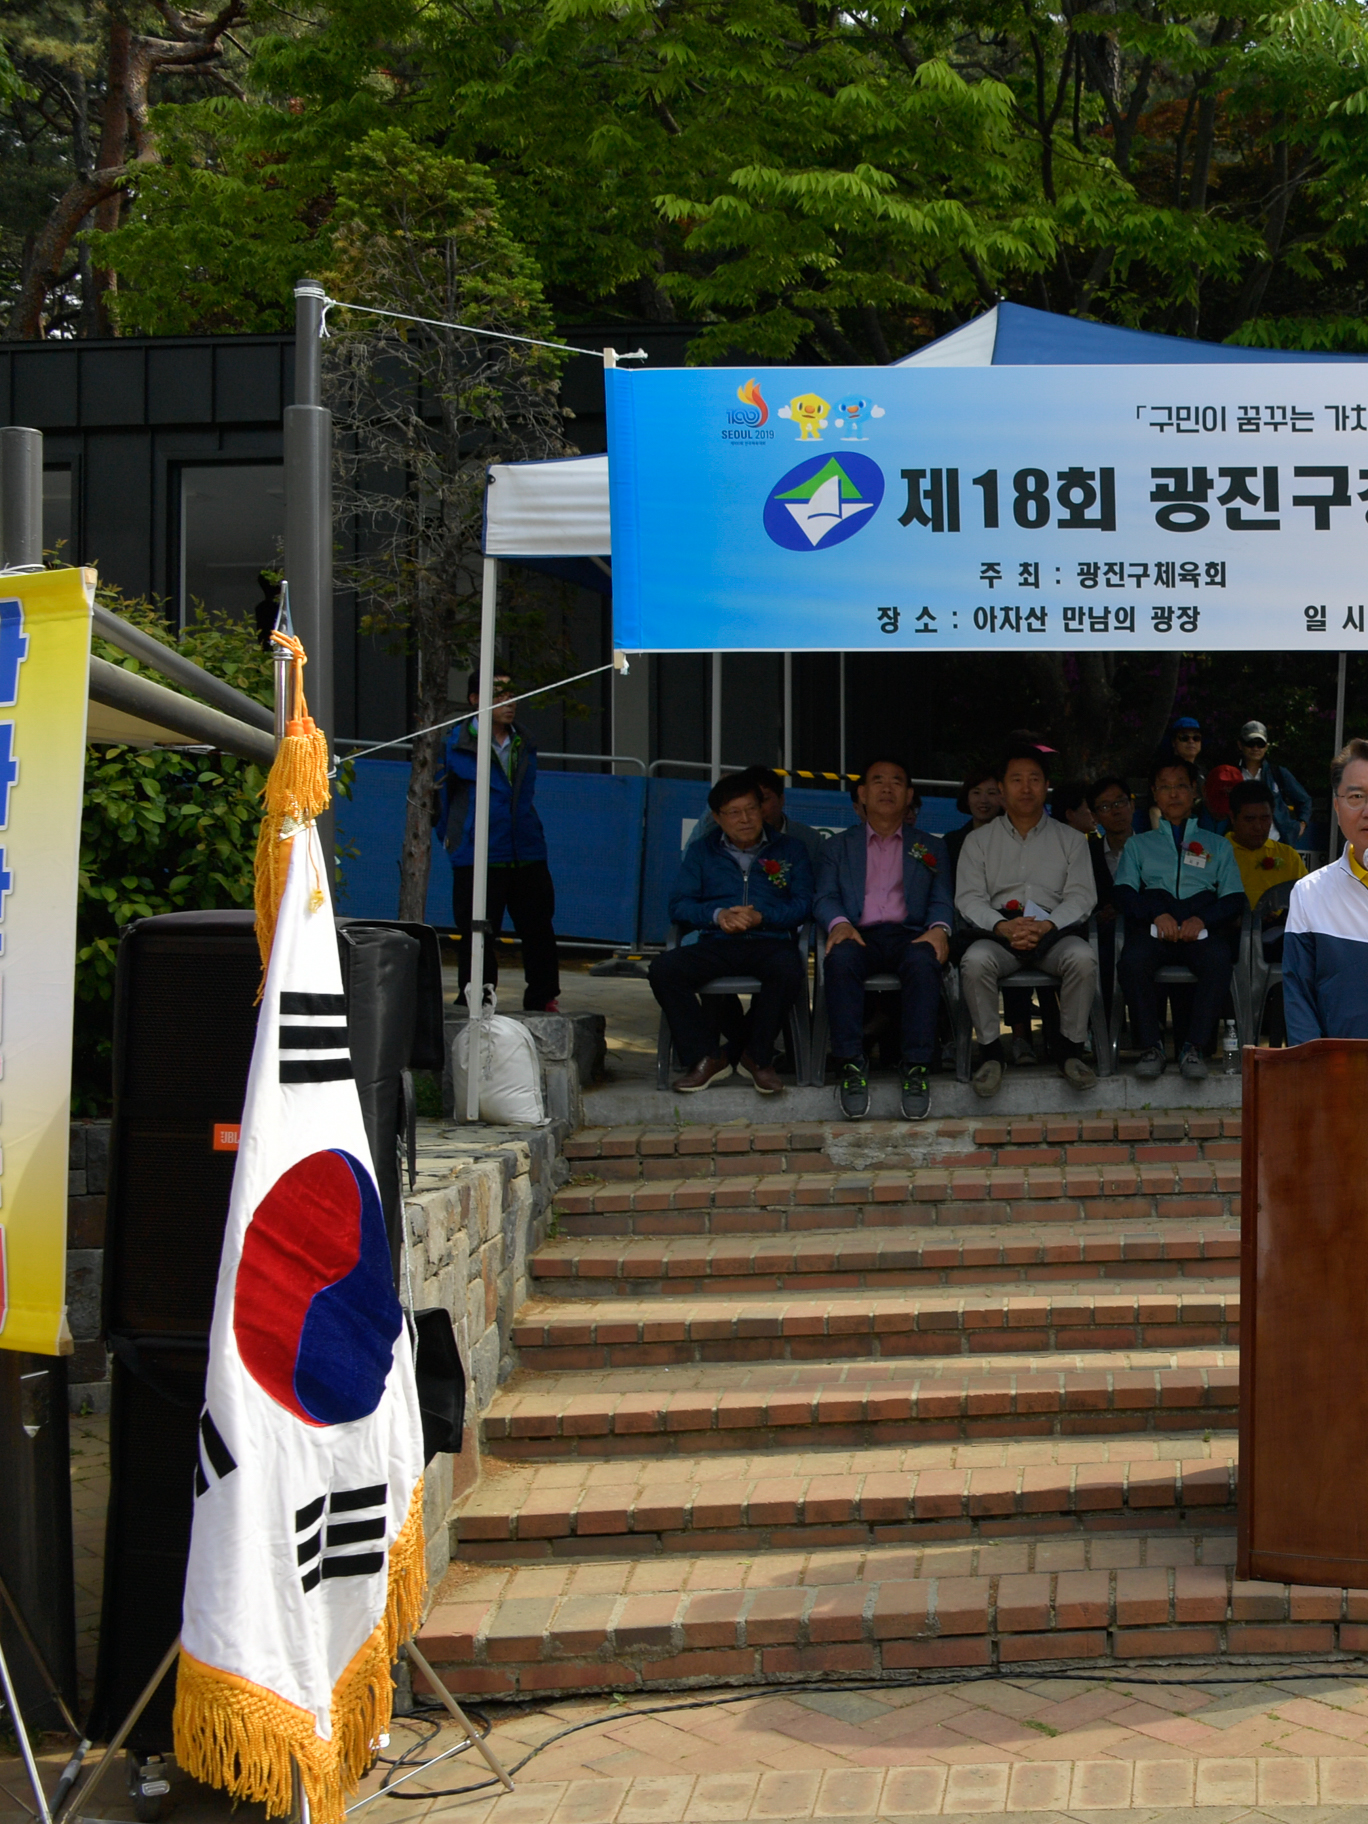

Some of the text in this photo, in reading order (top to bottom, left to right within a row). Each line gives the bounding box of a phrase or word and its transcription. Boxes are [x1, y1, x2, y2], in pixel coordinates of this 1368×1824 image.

[1236, 404, 1315, 433] 꿈꾸는
[721, 430, 775, 439] SEOUL 2019
[898, 465, 1117, 533] 제18회
[1076, 561, 1227, 590] 광진구체육회
[973, 605, 1048, 634] 아차산
[1062, 605, 1136, 633] 만남의
[1150, 605, 1201, 633] 광장
[221, 1131, 240, 1144] JBL
